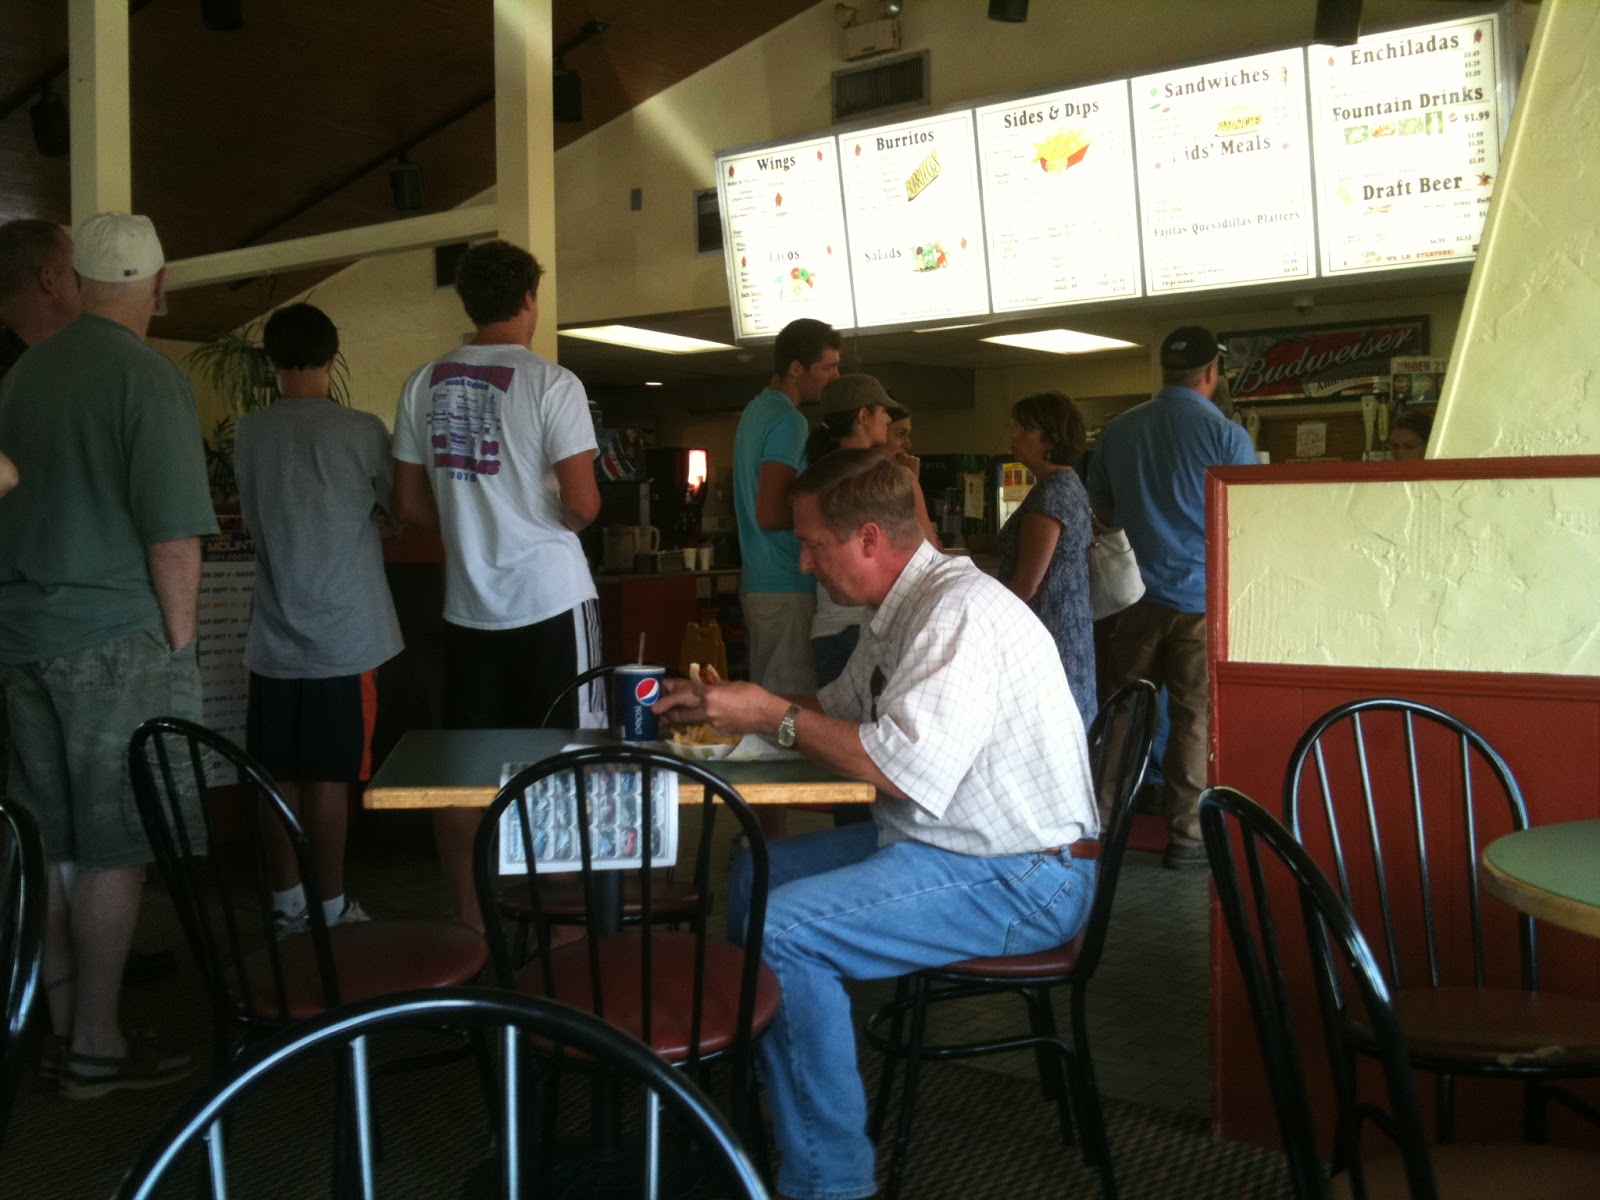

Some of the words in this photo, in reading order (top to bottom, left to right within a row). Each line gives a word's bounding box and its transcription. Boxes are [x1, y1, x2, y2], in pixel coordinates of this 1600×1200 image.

[1351, 34, 1460, 66] Enchiladas
[1165, 68, 1270, 98] Sandwiches
[1003, 109, 1044, 129] Sides
[1048, 105, 1060, 121] &
[1064, 100, 1100, 119] Dips
[1332, 97, 1413, 121] Fountain
[1419, 86, 1484, 109] Drinks
[1463, 110, 1490, 123] $1.99
[876, 130, 935, 151] Burritos
[1171, 143, 1214, 163] ids'
[1221, 135, 1271, 156] Meals
[757, 155, 796, 172] Wings
[1363, 179, 1412, 200] Draft
[1419, 175, 1463, 193] Beer
[1192, 218, 1252, 235] Quesadillas
[1256, 212, 1300, 225] Platters
[864, 247, 902, 263] Salads
[1231, 327, 1414, 396] Budweiser
[1396, 360, 1431, 373] UNDER
[1434, 360, 1447, 372] 21
